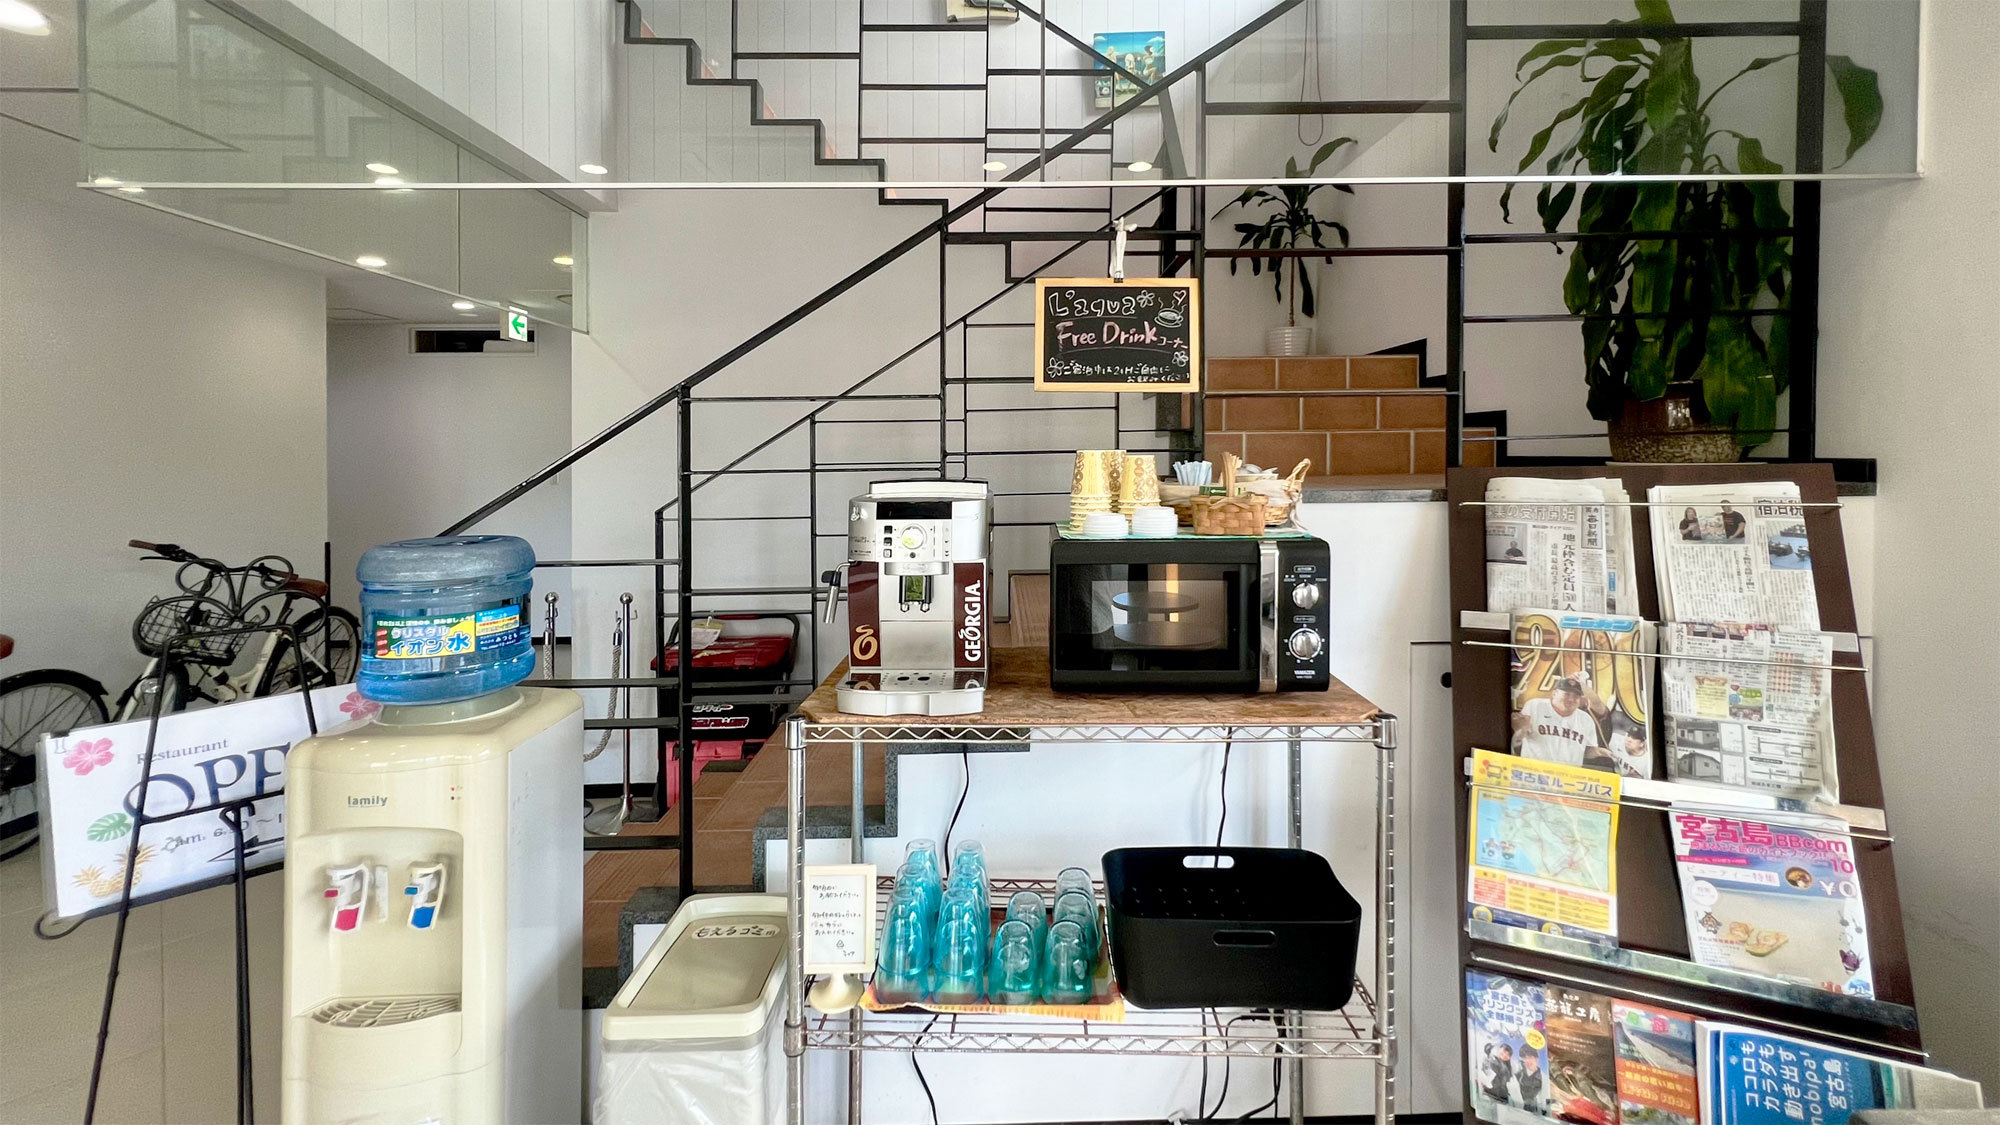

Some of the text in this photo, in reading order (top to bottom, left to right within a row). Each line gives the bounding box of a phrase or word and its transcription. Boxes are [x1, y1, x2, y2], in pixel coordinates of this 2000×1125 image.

[1055, 321, 1098, 351] Free
[1102, 321, 1158, 345] Drink
[391, 632, 471, 656] イオン水
[958, 580, 982, 662] GEORGIA
[1537, 724, 1585, 745] GIANTS
[1831, 859, 1855, 874] 10
[1740, 1040, 1760, 1108] ココロも
[1758, 1043, 1781, 1113] カラダも
[1778, 1046, 1805, 1121] 動き出す
[1822, 1059, 1848, 1110] 宮古島
